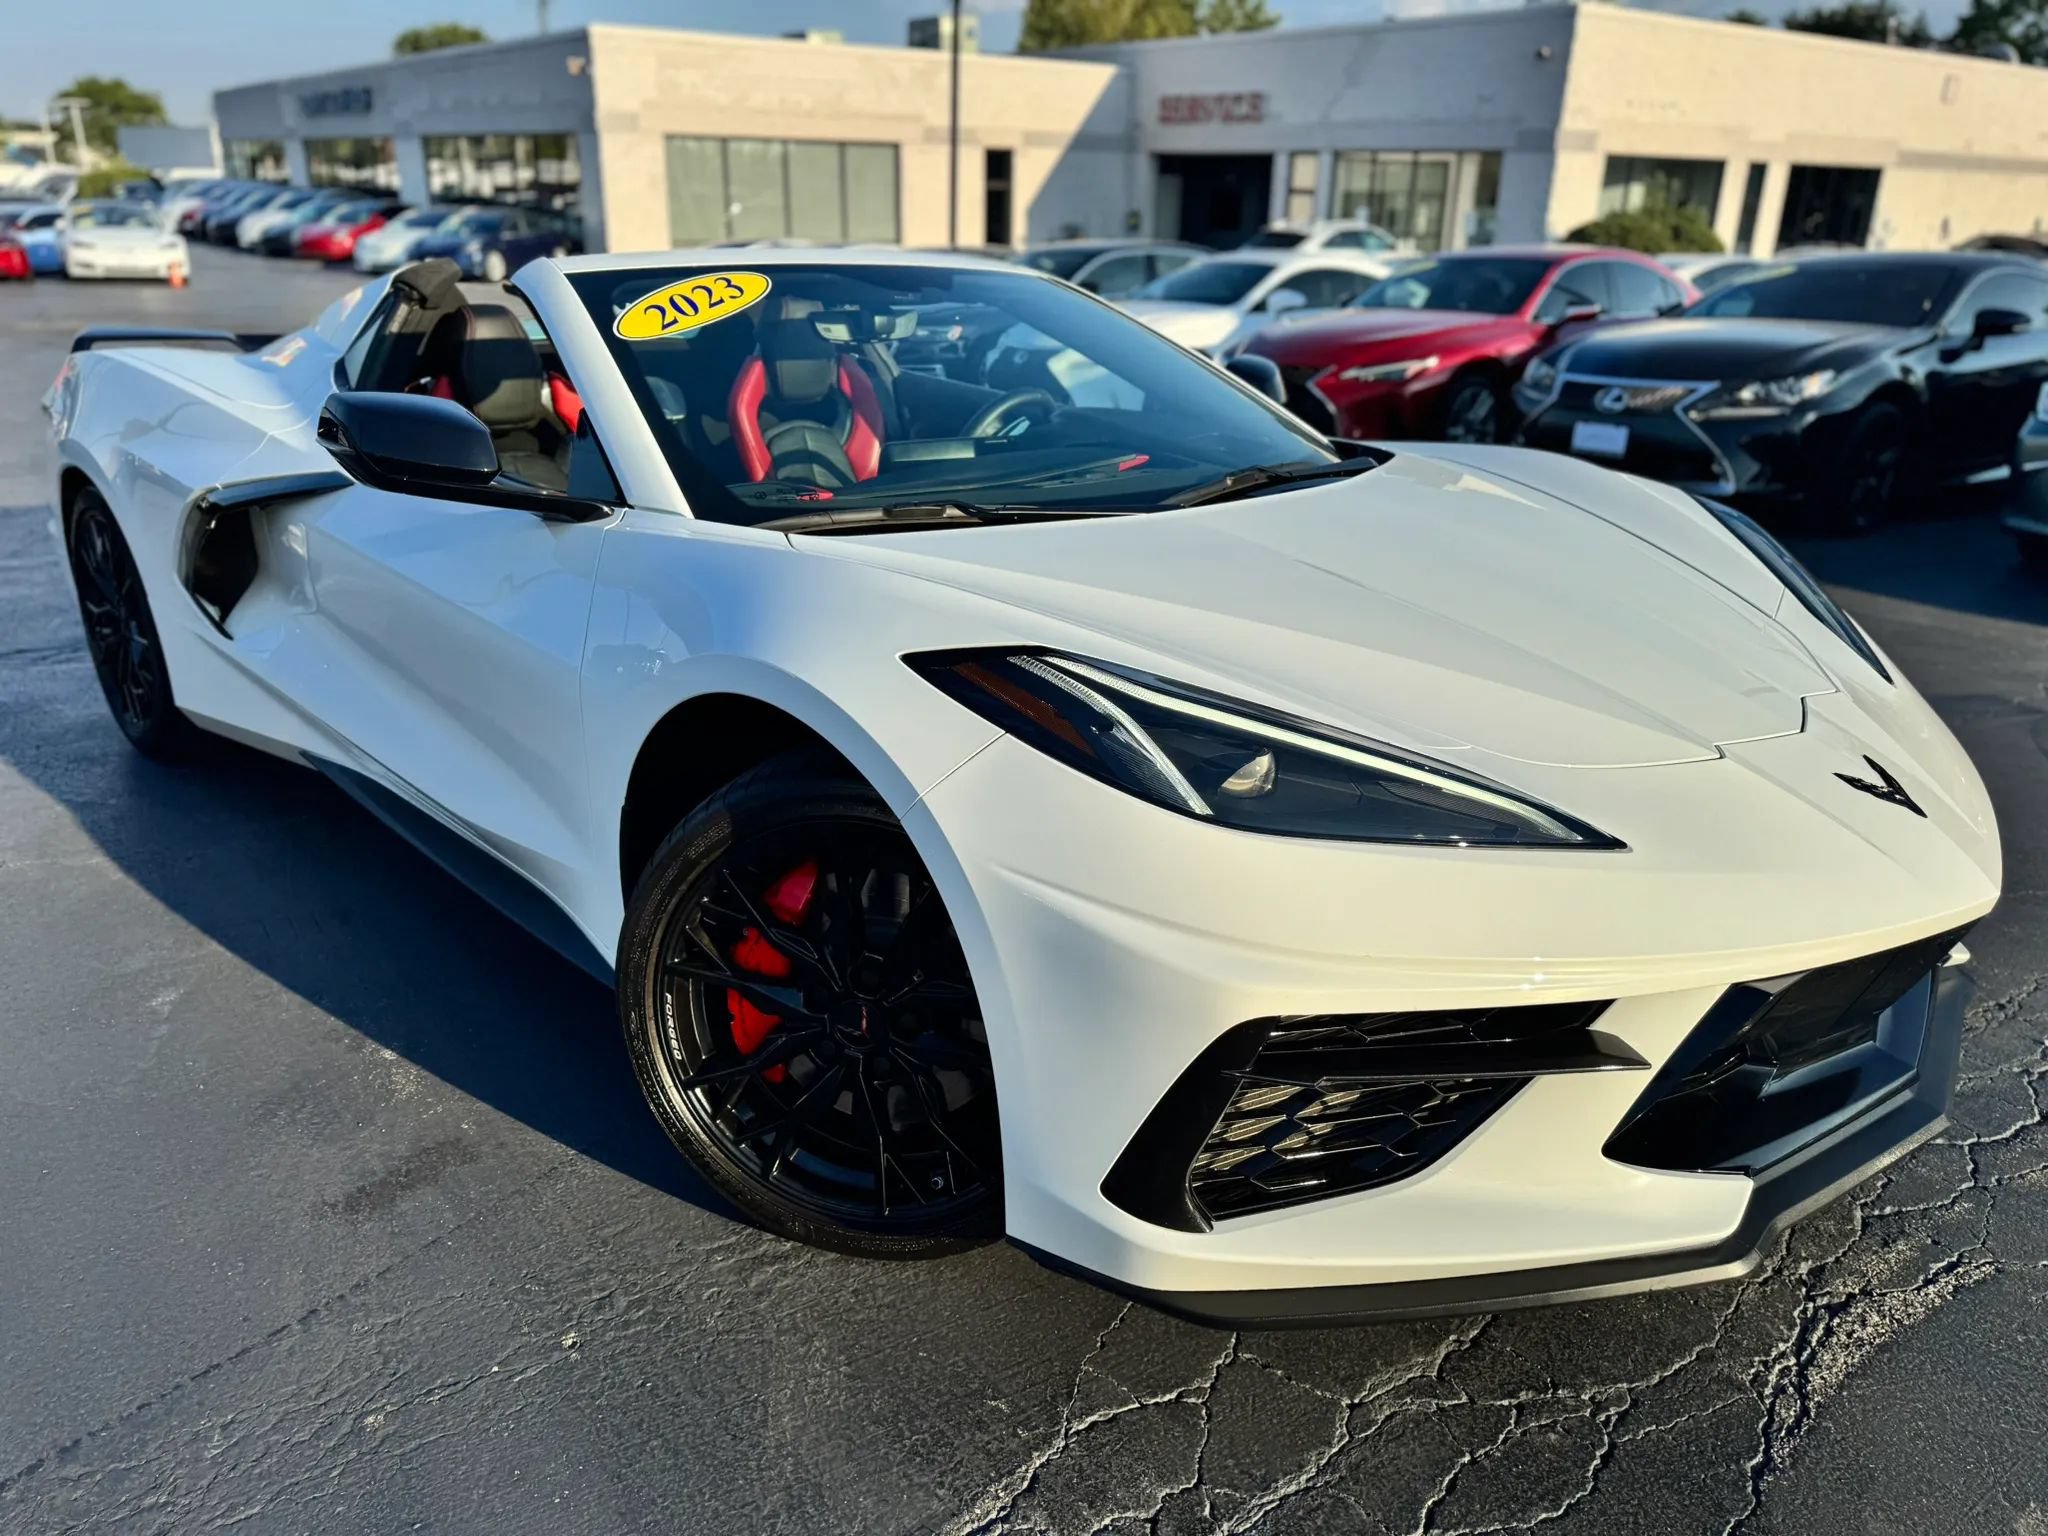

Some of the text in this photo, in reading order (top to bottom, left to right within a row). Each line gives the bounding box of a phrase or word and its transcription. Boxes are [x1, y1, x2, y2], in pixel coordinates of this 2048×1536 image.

[1159, 91, 1263, 123] SERVICE
[644, 276, 745, 331] 2023
[665, 992, 683, 1060] FORGED
